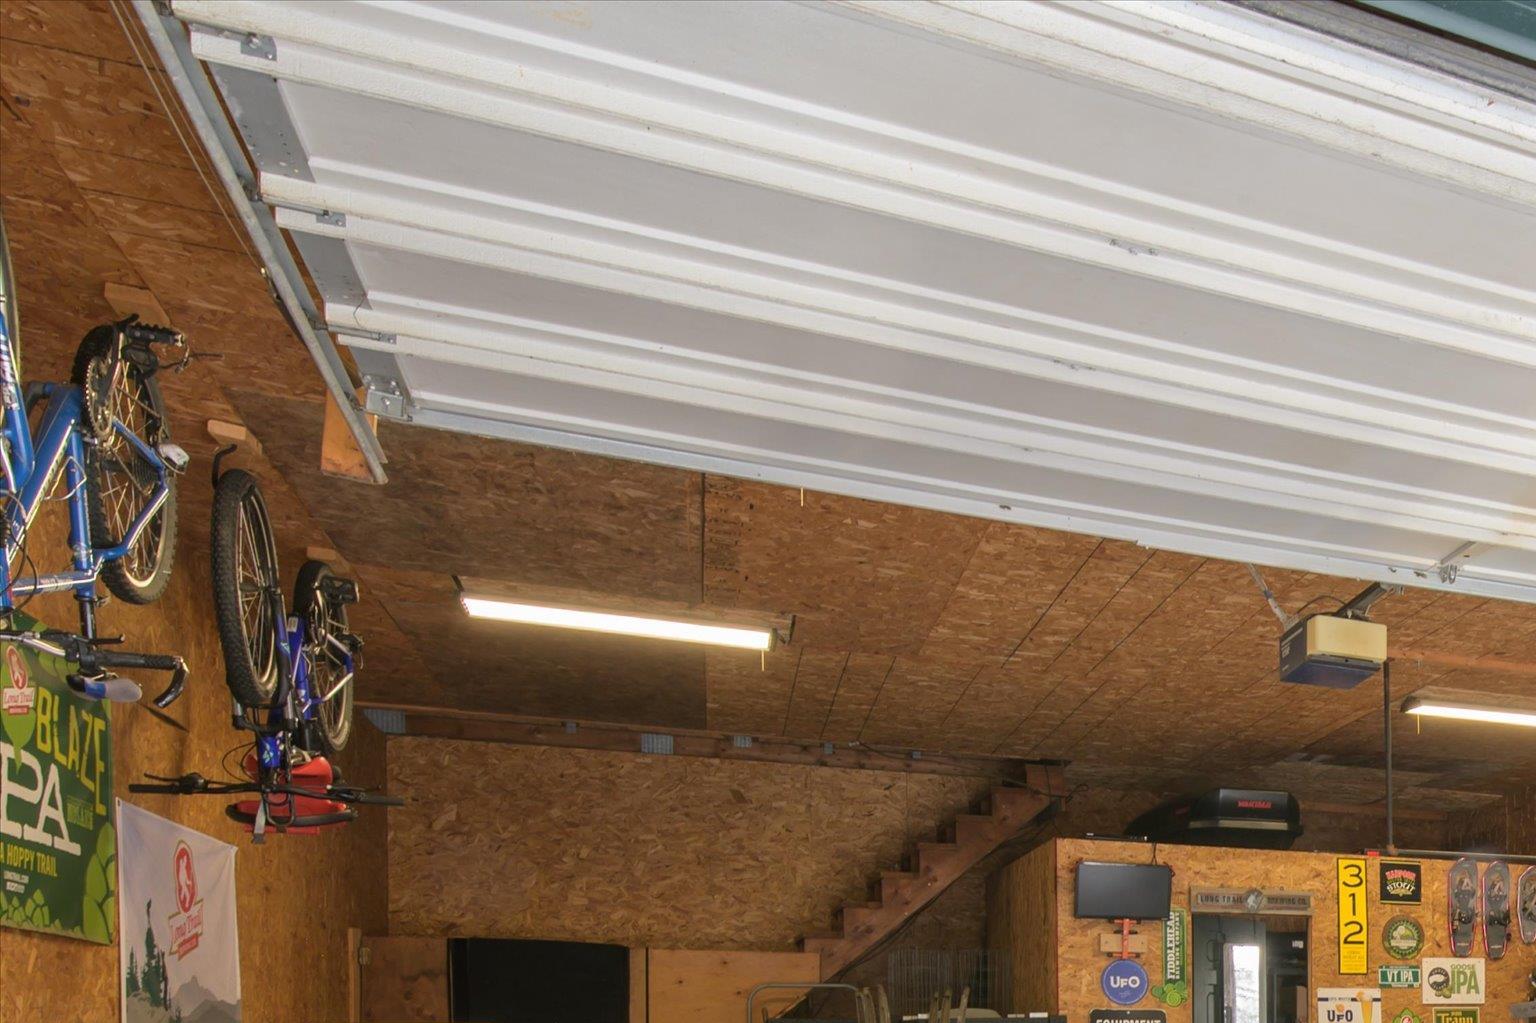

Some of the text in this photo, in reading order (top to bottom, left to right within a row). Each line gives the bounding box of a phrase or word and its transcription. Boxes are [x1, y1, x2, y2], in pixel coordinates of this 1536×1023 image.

[36, 684, 107, 817] BLAZE
[6, 843, 35, 871] HOPPY
[36, 851, 58, 878] TRAIL
[1342, 863, 1365, 945] 312
[1109, 975, 1141, 989] UFO
[1386, 969, 1414, 982] VT IPA
[1450, 969, 1480, 995] IPA
[1327, 1009, 1354, 1023] UFO
